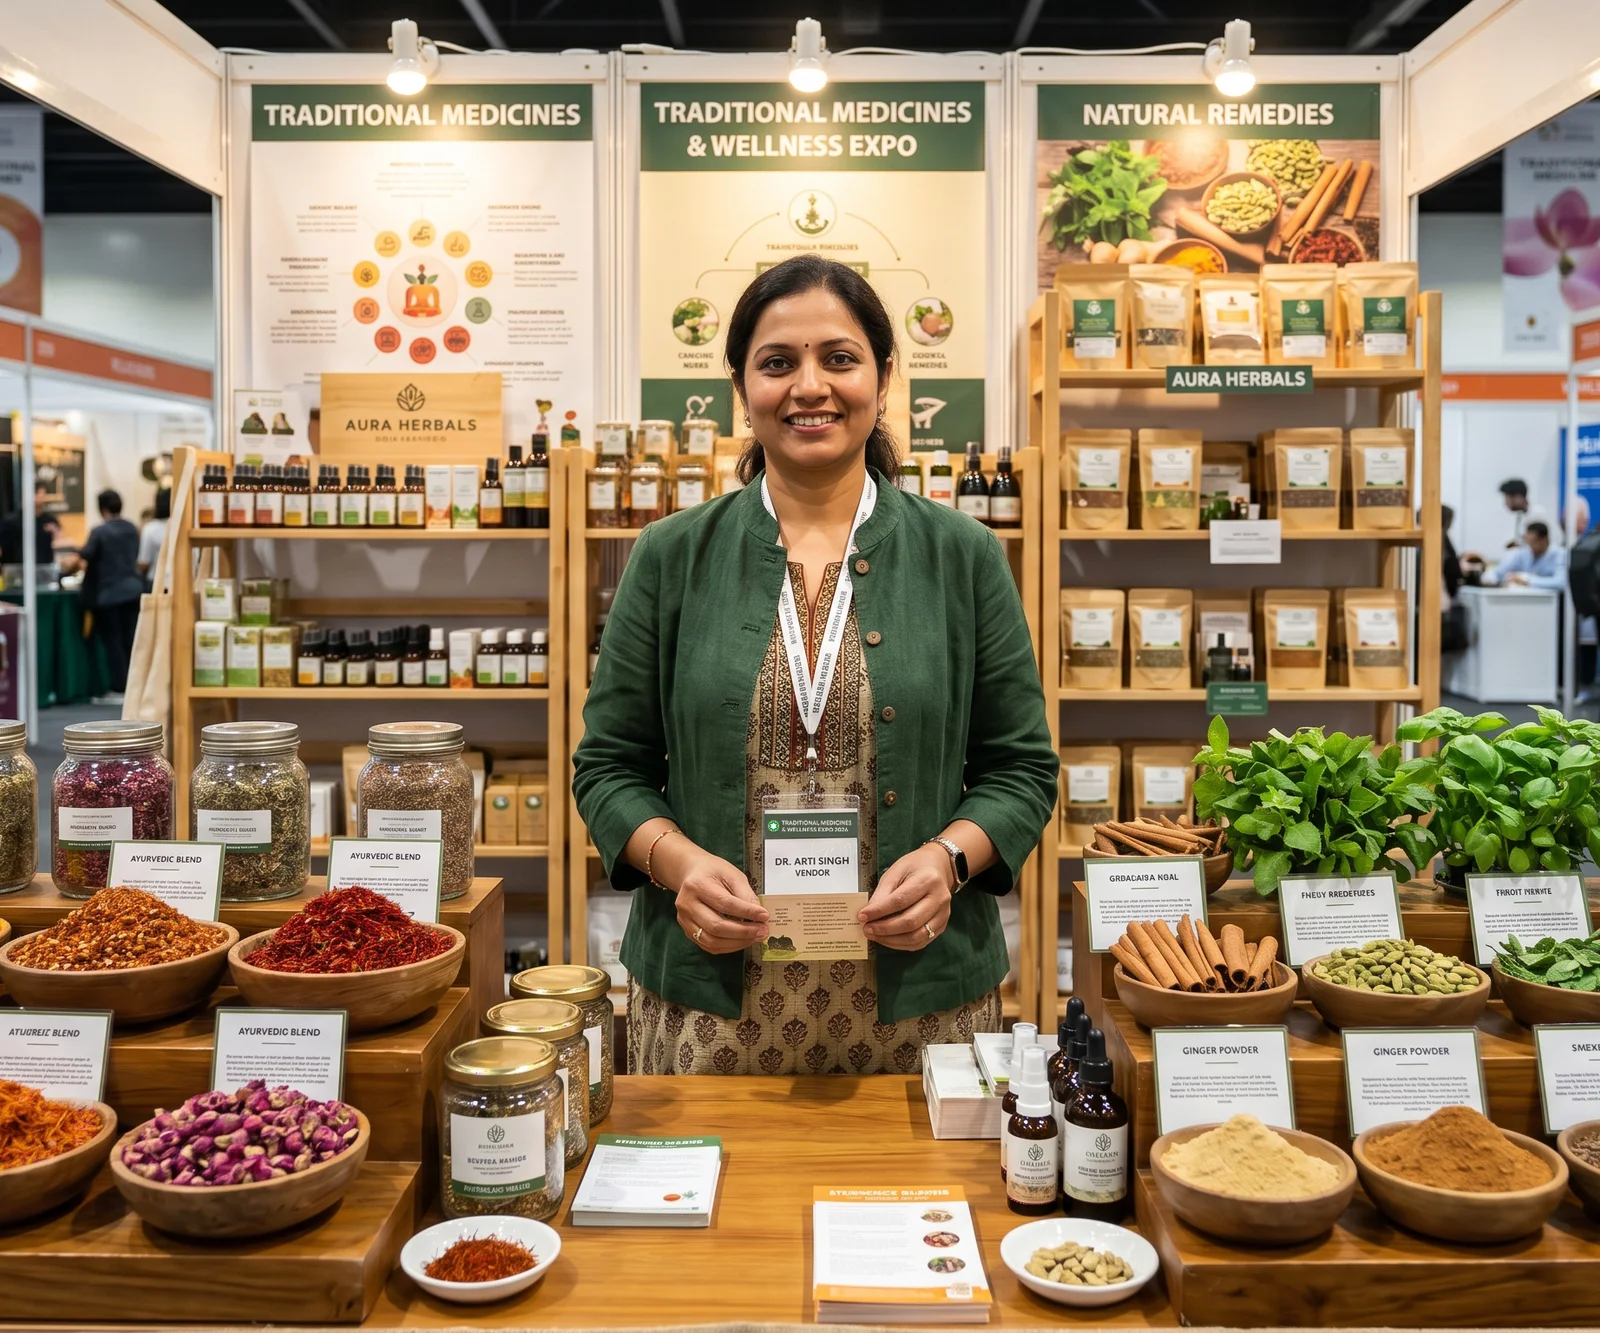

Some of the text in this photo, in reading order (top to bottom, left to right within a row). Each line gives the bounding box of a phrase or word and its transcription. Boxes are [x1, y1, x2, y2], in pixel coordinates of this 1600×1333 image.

[264, 104, 581, 127] TRADITIONAL MEDICINES
[654, 101, 972, 124] TRADITIONAL MEDICINES
[1083, 103, 1334, 126] NATURAL REMEDIES
[687, 134, 917, 157] & WELLNESS EXPO
[1172, 371, 1306, 388] AURA HERBALS
[345, 419, 477, 431] AURA HERBALS
[130, 855, 174, 863] AYURVEDIC
[350, 852, 421, 861] AYURVEDIC BLEND
[775, 857, 850, 866] DR. ARTI SINGH
[795, 869, 830, 877] VENDOR
[52, 1029, 80, 1037] BLEND
[238, 1027, 321, 1036] AYURVEDIC BLEND
[1182, 1046, 1259, 1055] GINGER POWDER
[1373, 1047, 1450, 1056] GINGER POWDER
